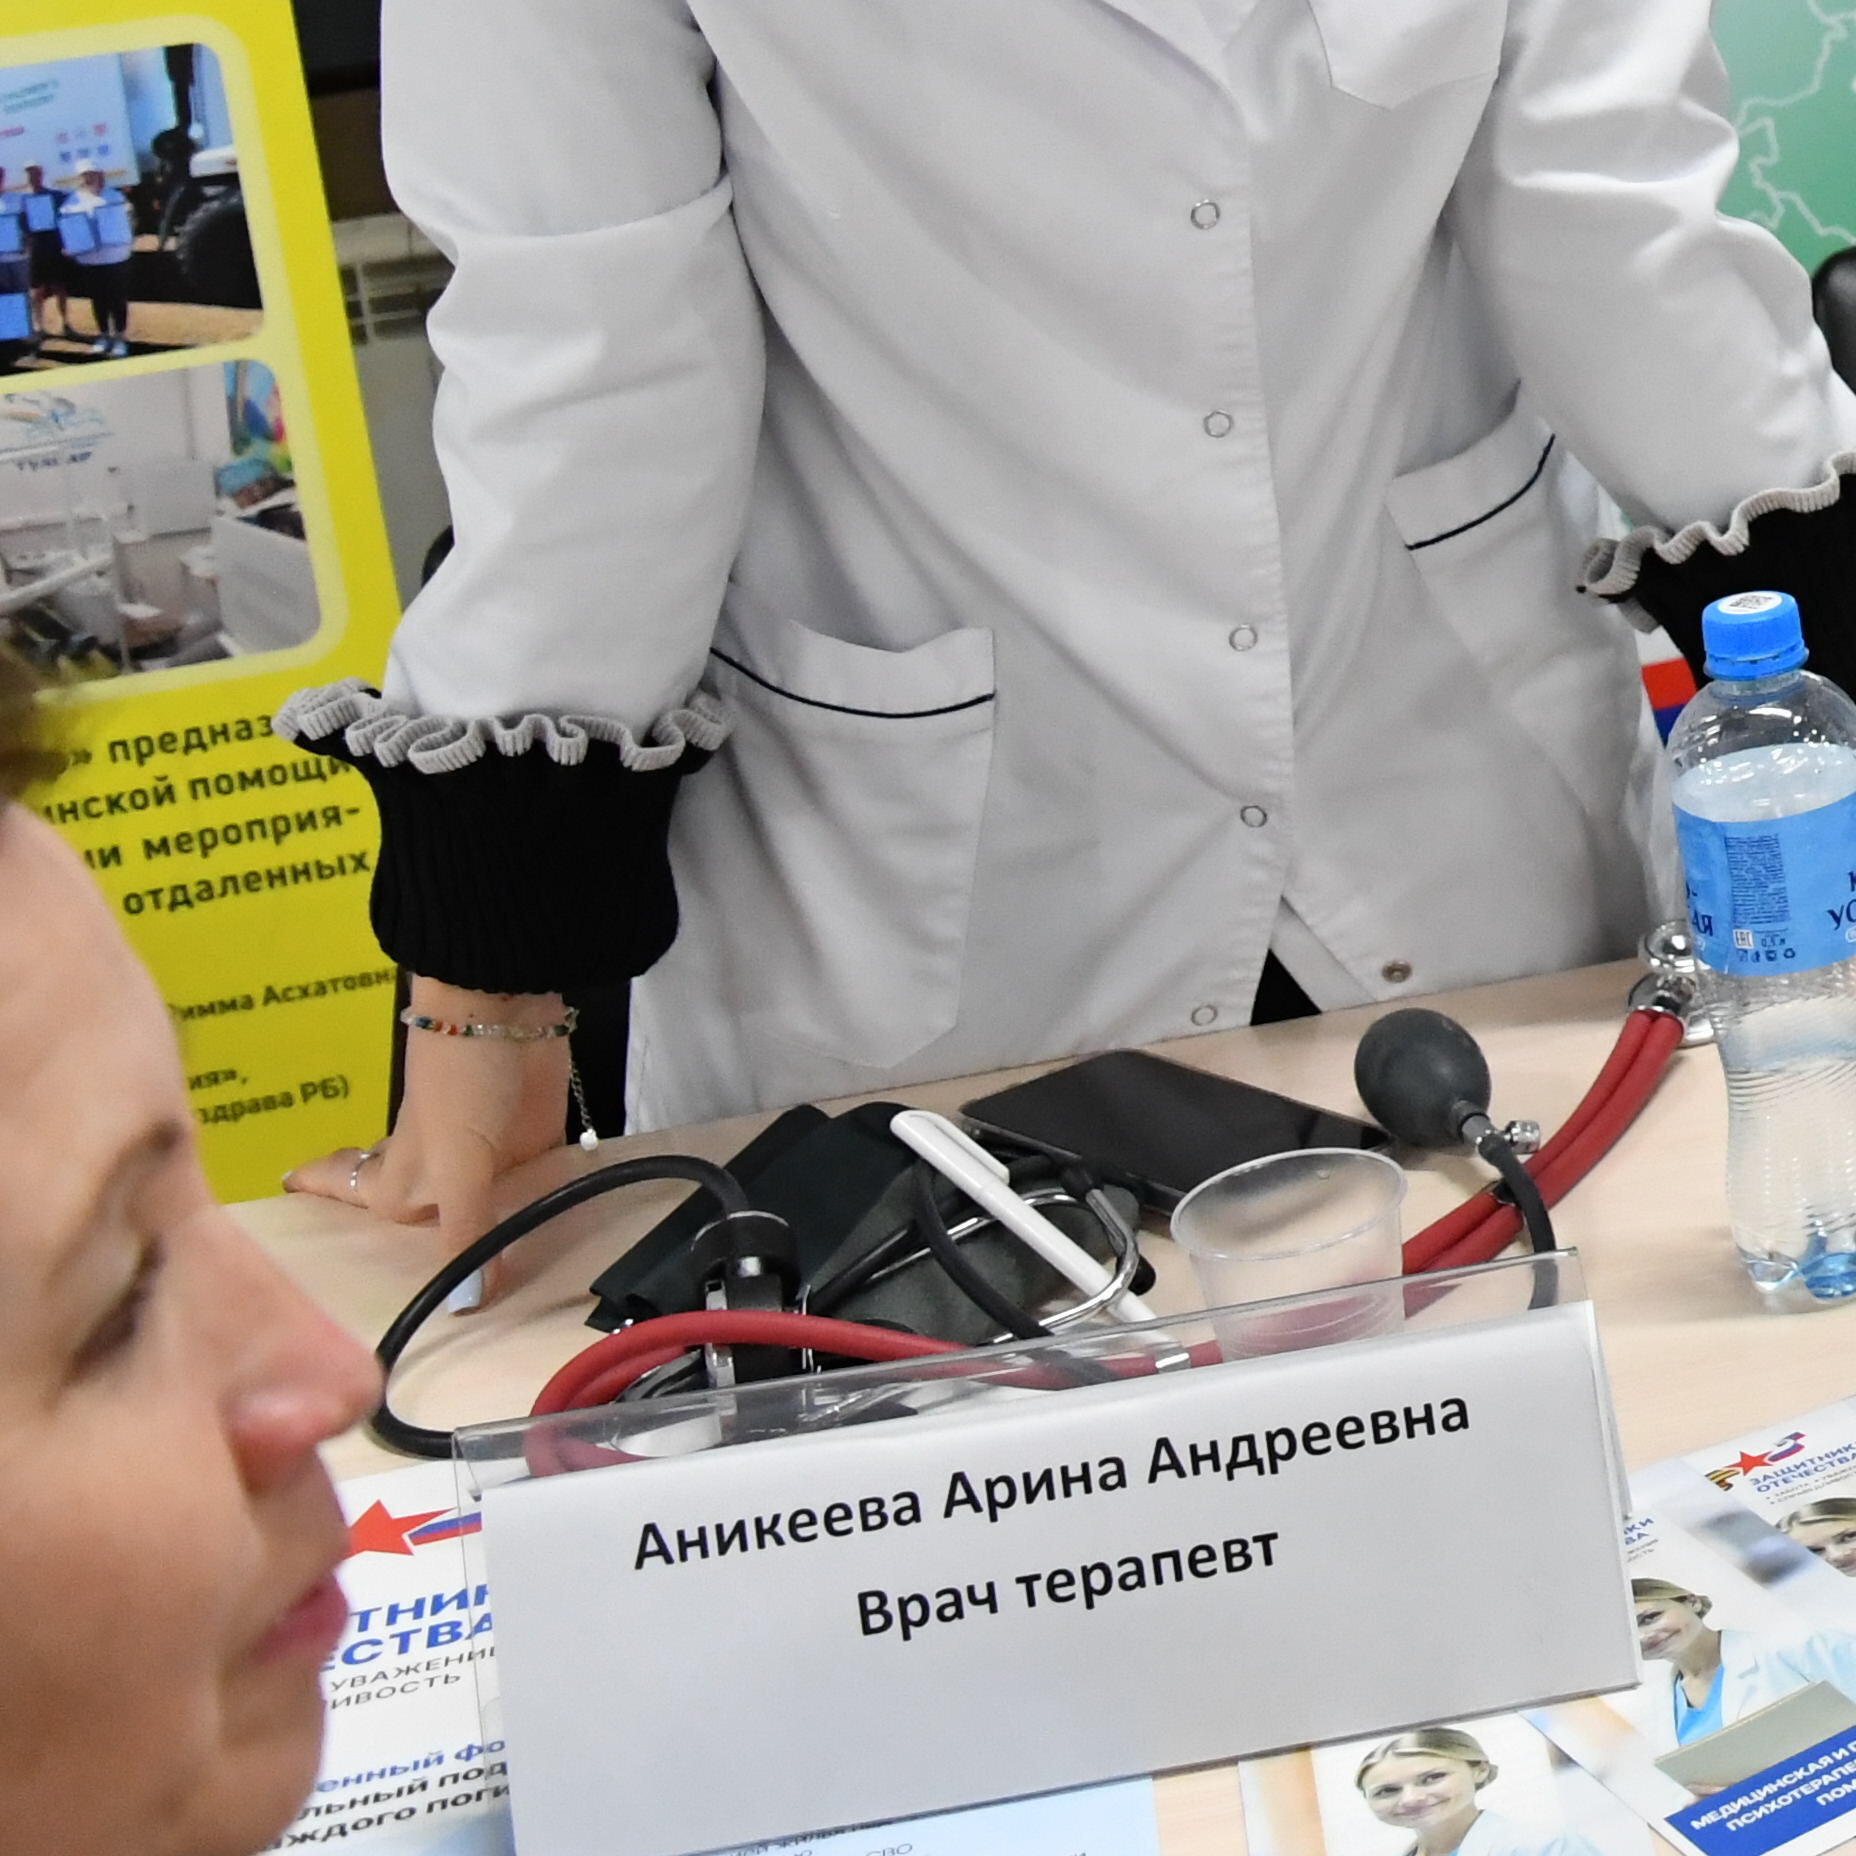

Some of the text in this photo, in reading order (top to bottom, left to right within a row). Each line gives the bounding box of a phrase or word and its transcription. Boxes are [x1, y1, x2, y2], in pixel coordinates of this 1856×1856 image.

[107, 713, 274, 769] предназ
[142, 803, 361, 865] мероприя-
[122, 848, 372, 919] отдаленных
[300, 1073, 352, 1105] РБ)
[633, 1390, 1473, 1572] Аникеева Арина Андреевна
[857, 1526, 1281, 1641] Врач терапевт
[330, 1672, 461, 1711] ИВОСТЬ
[298, 1776, 428, 1821] льный
[313, 1749, 445, 1793] енный
[1690, 1754, 1835, 1831] МЕДИЦИНСКАЯ
[1832, 1745, 1850, 1763] И
[275, 1804, 417, 1849] ждого
